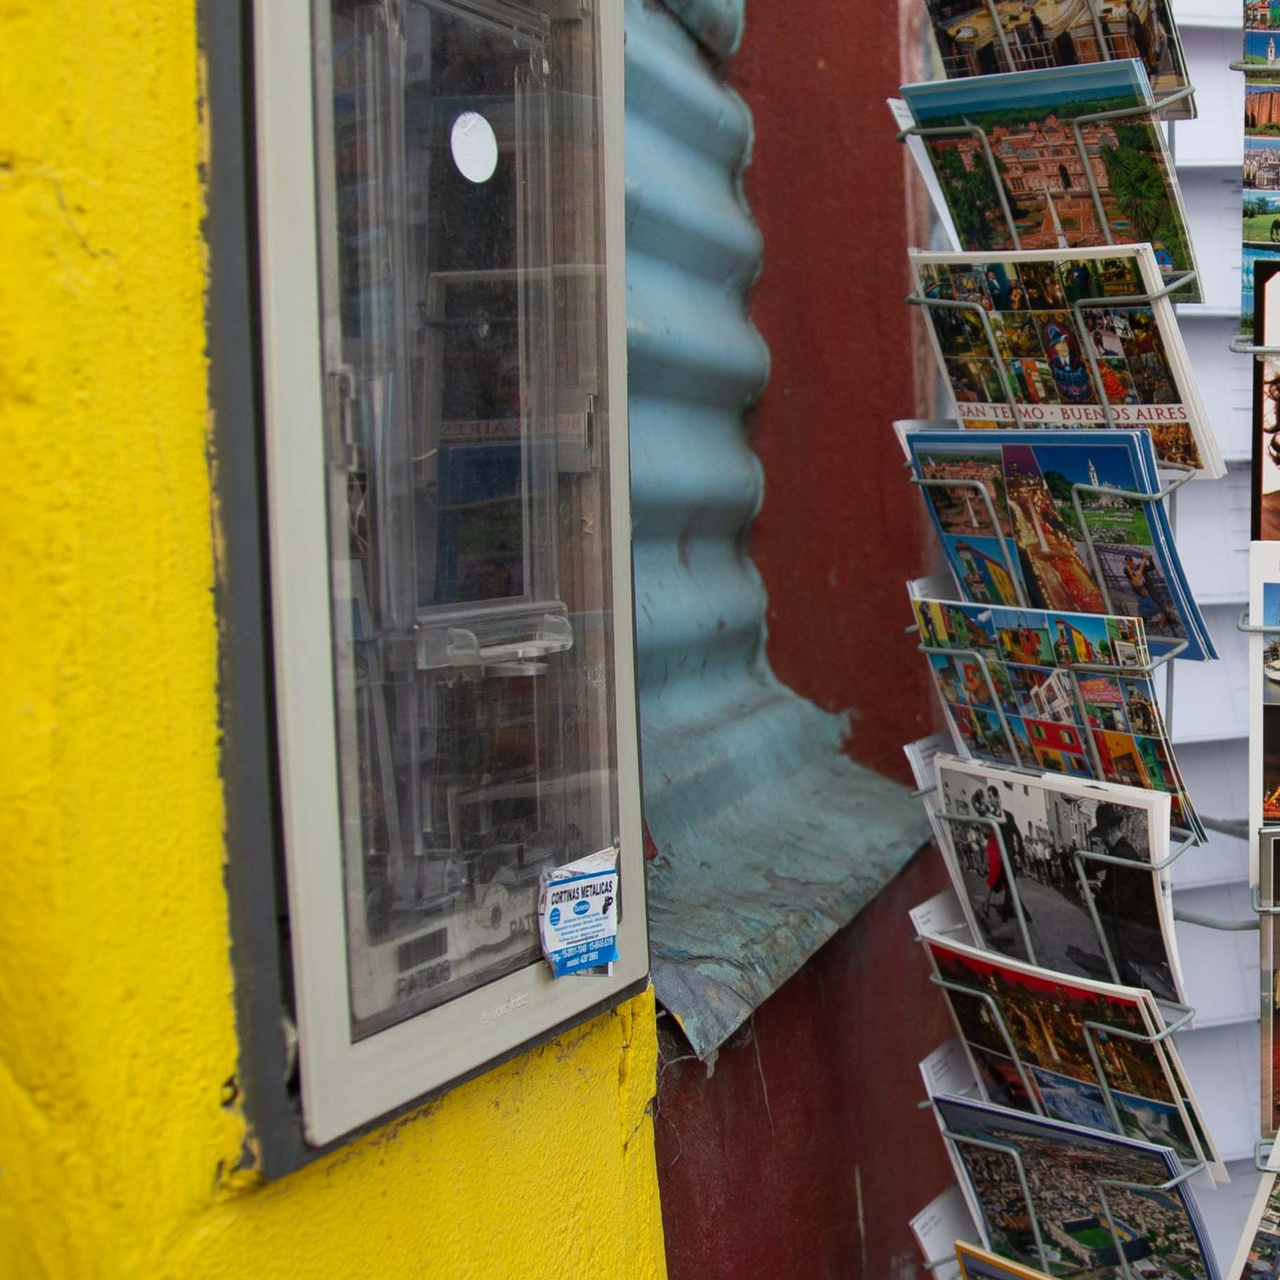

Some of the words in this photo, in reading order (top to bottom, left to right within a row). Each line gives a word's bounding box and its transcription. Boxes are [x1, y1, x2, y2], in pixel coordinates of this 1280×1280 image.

[958, 404, 987, 417] SAN
[1136, 406, 1188, 421] AIRES
[551, 887, 580, 905] CORTINAS
[580, 880, 613, 899] METALICAS
